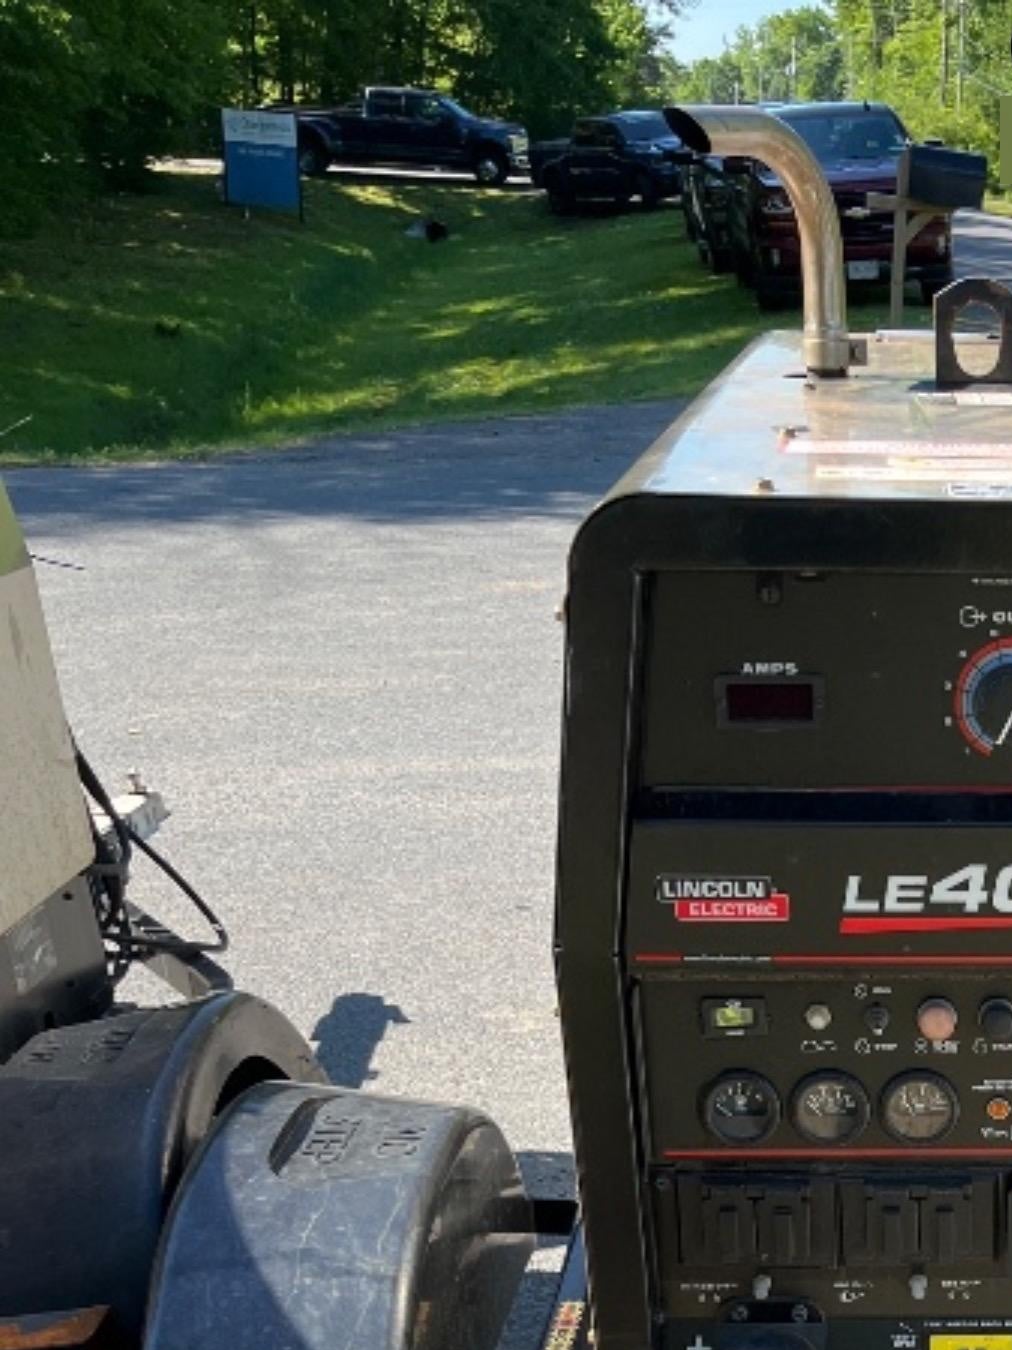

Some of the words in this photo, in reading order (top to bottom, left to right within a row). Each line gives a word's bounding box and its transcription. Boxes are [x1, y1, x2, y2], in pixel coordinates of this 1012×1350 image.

[742, 662, 799, 675] AMPS
[662, 881, 766, 899] LINCOLN
[689, 903, 779, 917] ELECTRIC
